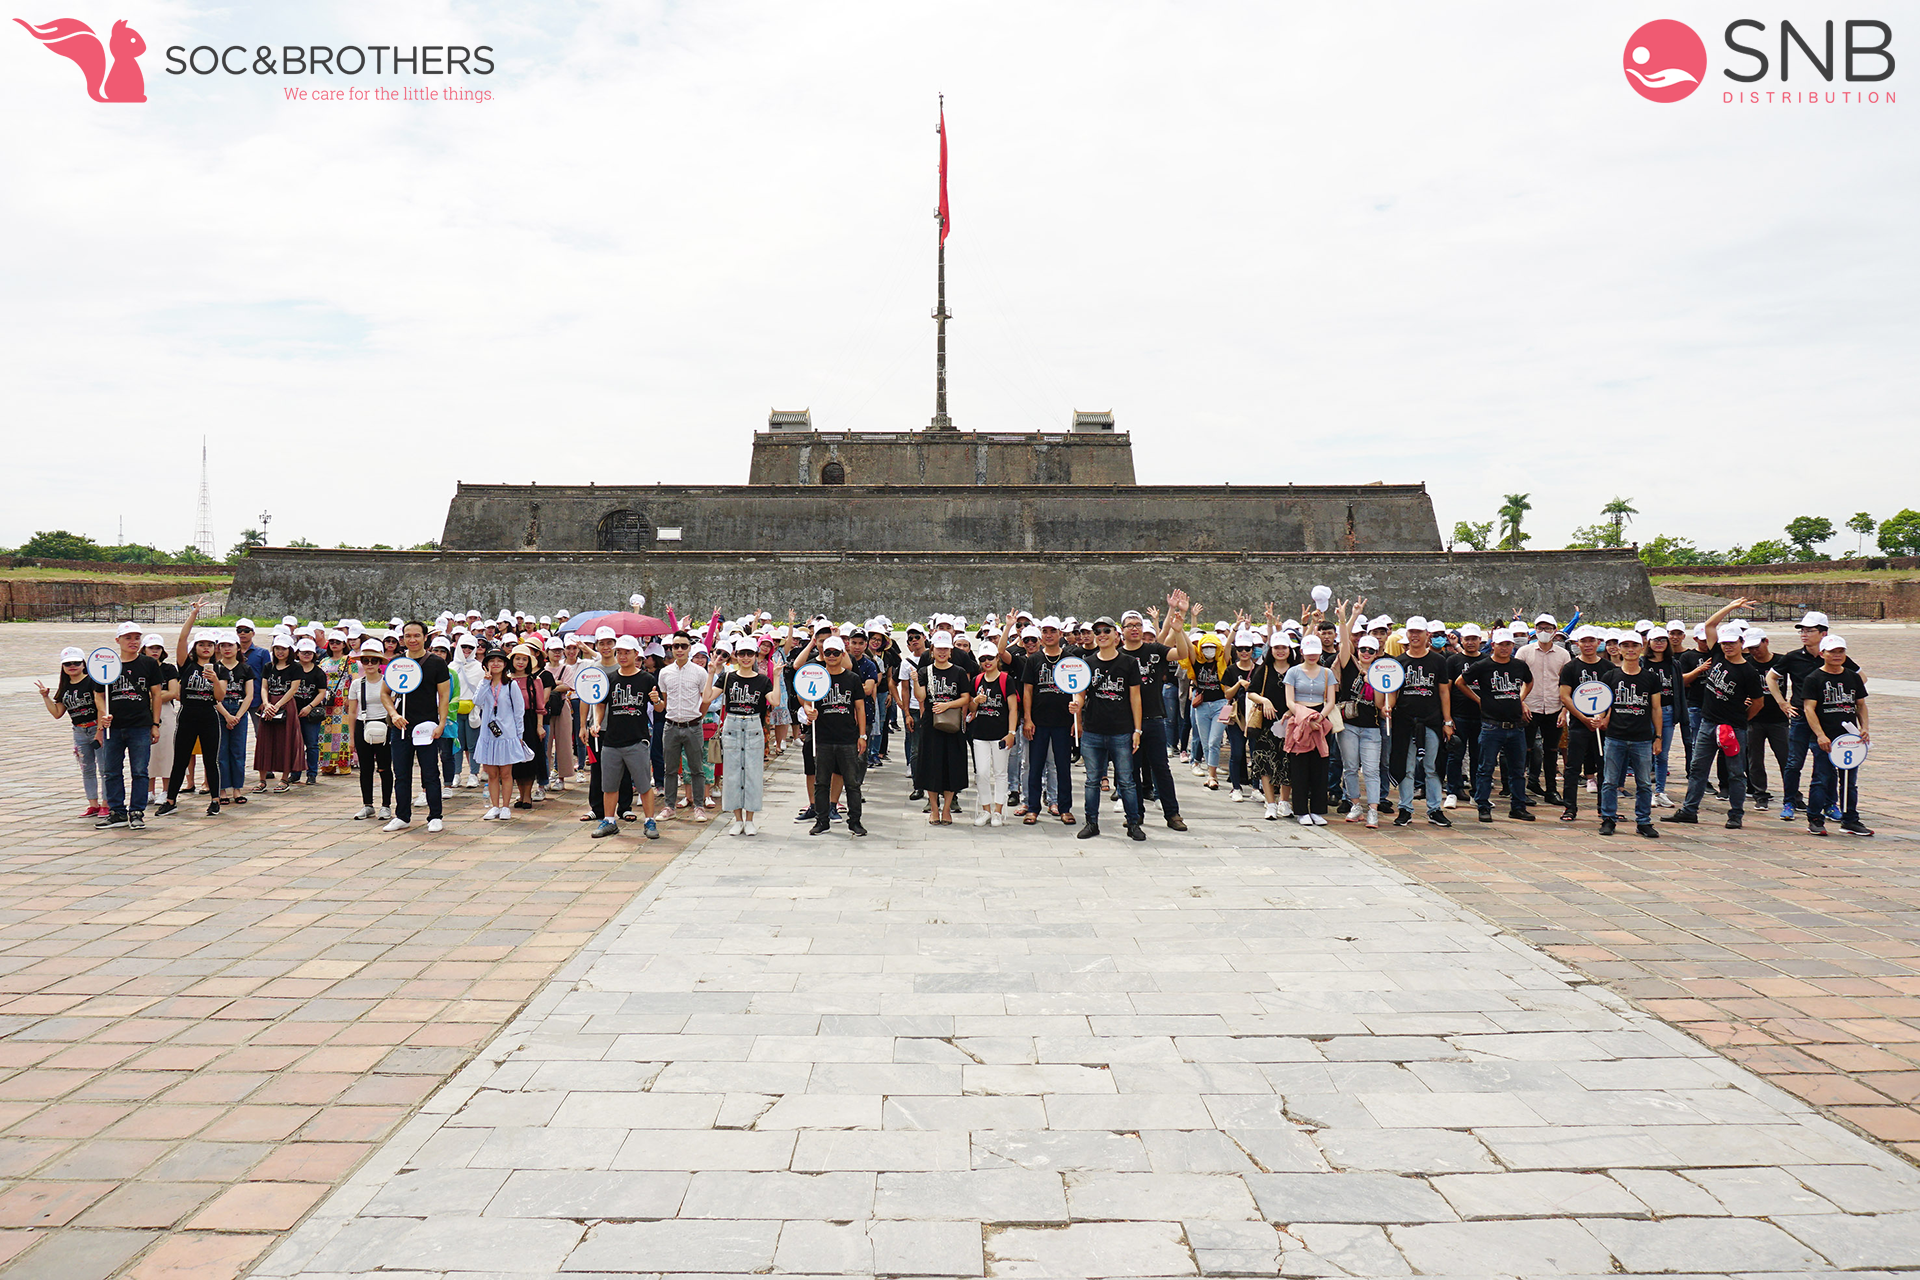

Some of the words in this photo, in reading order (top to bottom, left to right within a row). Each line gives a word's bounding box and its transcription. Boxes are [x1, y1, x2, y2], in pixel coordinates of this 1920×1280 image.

[101, 664, 108, 680] 1
[398, 673, 409, 689] 2
[807, 681, 818, 697] 4
[1068, 673, 1078, 690] 5
[1381, 674, 1391, 689] 6
[592, 683, 601, 700] 3
[1587, 696, 1598, 711] 7
[1843, 750, 1853, 766] 8
